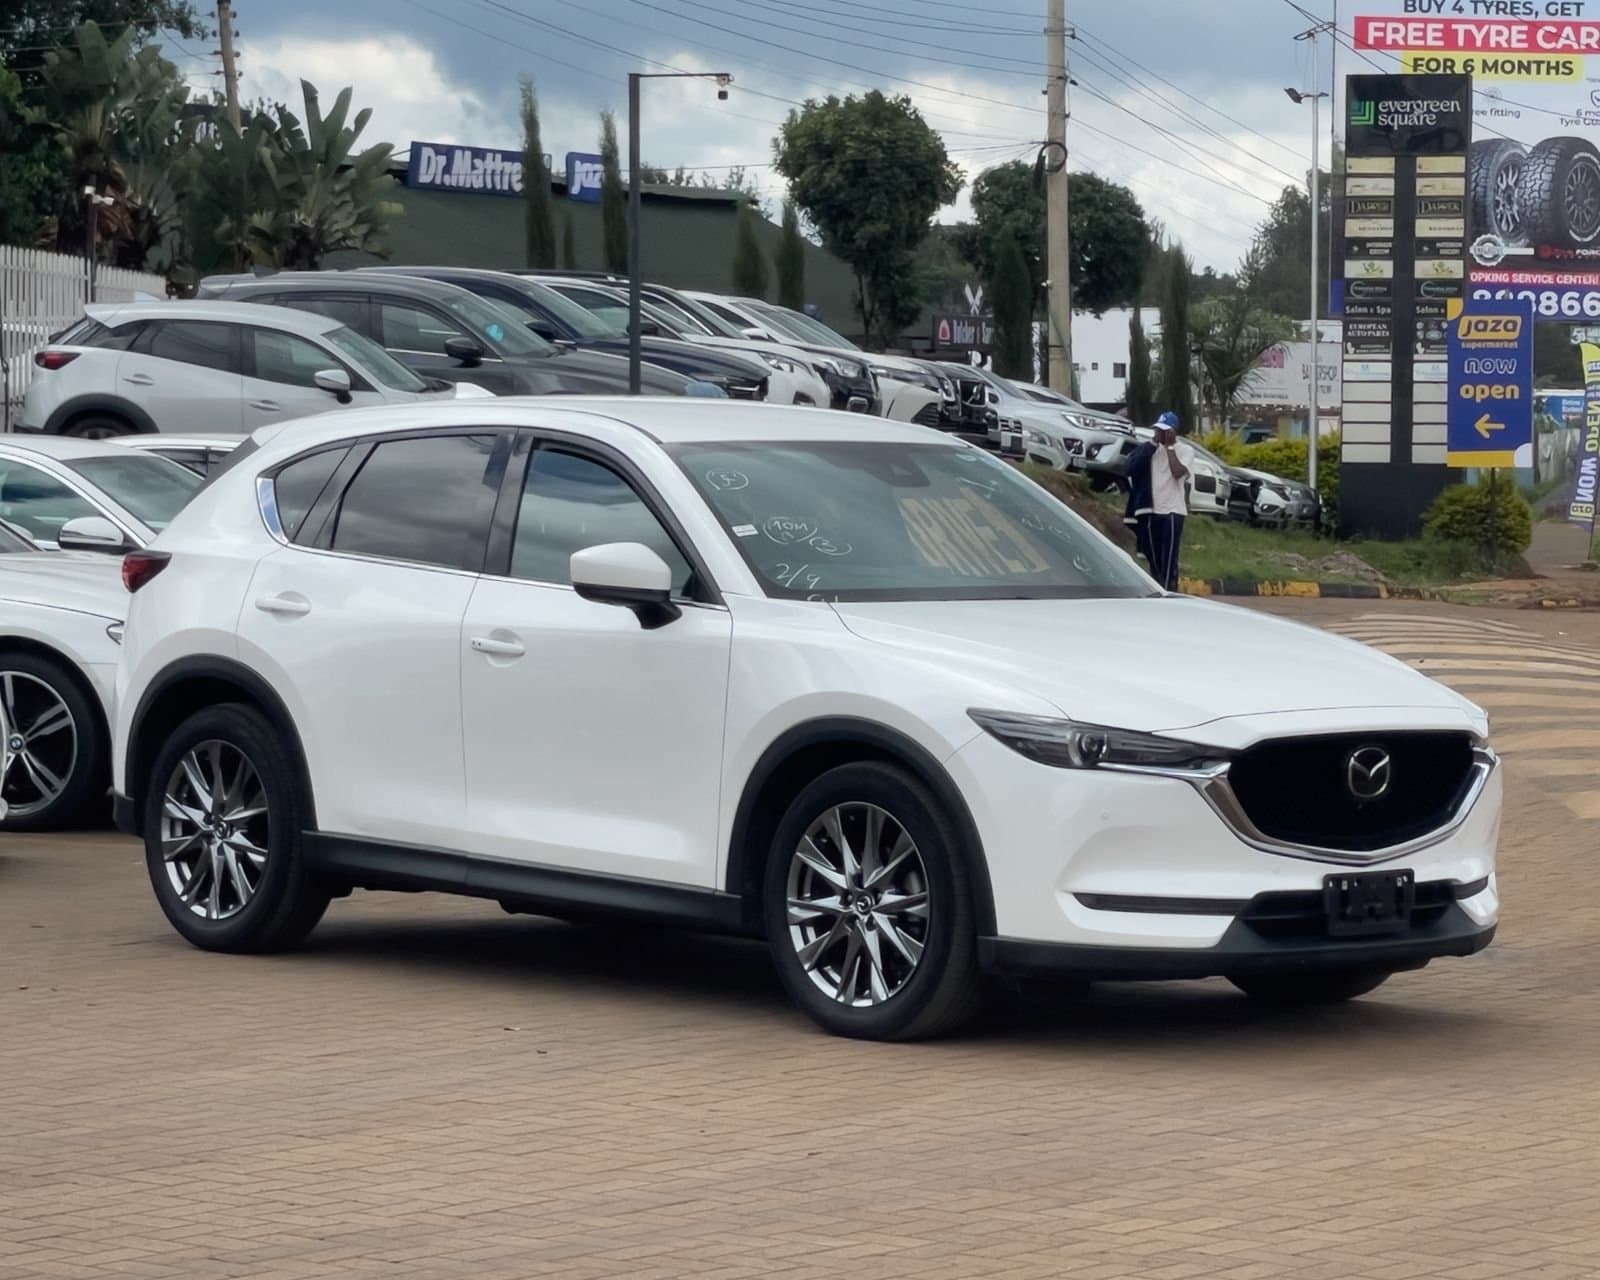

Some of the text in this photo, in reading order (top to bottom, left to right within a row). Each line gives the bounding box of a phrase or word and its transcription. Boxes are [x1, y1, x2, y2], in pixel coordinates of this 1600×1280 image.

[1404, 0, 1584, 18] BUY 4 TYRES, GET
[1367, 21, 1600, 49] FREE TYRE CAR
[1412, 57, 1574, 76] FOR 6 MONTHS
[1378, 100, 1461, 115] evergreen
[1489, 108, 1521, 119] fitting
[1378, 113, 1437, 131] square
[418, 147, 525, 192] Dr.Mattre
[570, 160, 605, 195] jaz
[1469, 271, 1509, 283] OPKING
[1511, 273, 1554, 284] SERVICE
[1349, 323, 1388, 331] EUROPEAN
[1462, 319, 1518, 337] jaza
[1461, 341, 1519, 350] supermarket
[1464, 358, 1517, 374] now
[1460, 384, 1520, 403] open
